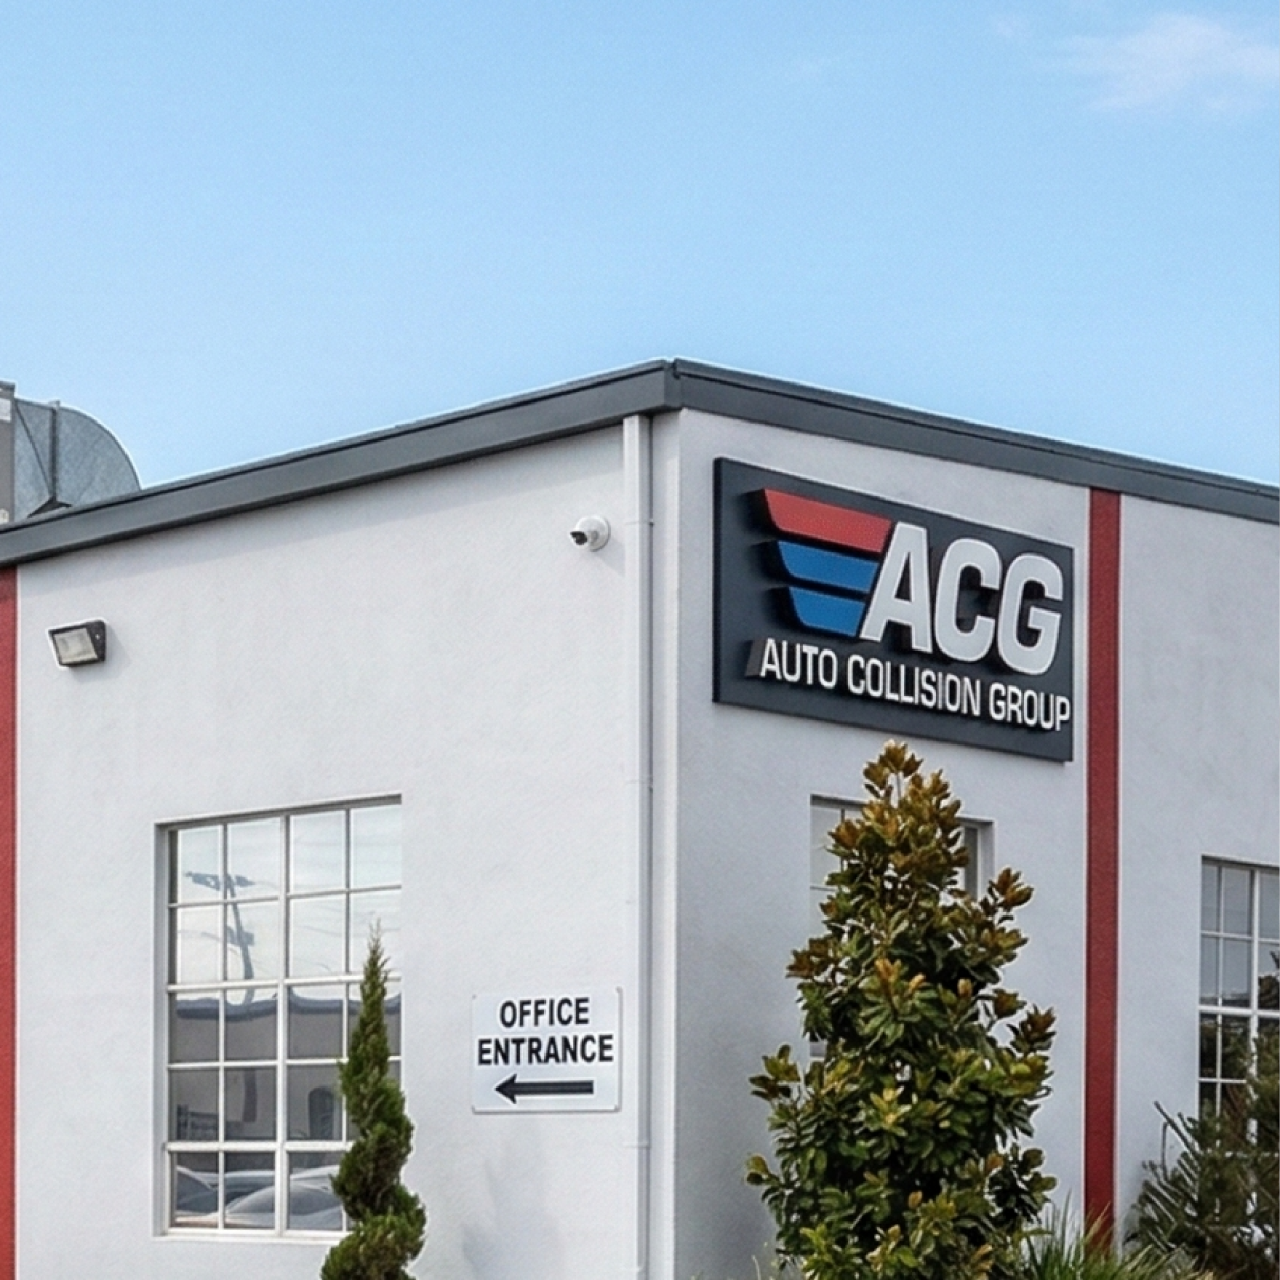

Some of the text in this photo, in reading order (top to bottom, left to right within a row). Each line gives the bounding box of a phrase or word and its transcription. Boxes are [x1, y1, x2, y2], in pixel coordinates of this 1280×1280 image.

[859, 520, 1064, 676] ACG
[759, 637, 1071, 732] AUTO COLLISION GROUP
[499, 996, 590, 1028] OFFICE
[477, 1034, 614, 1066] ENTRANCE
